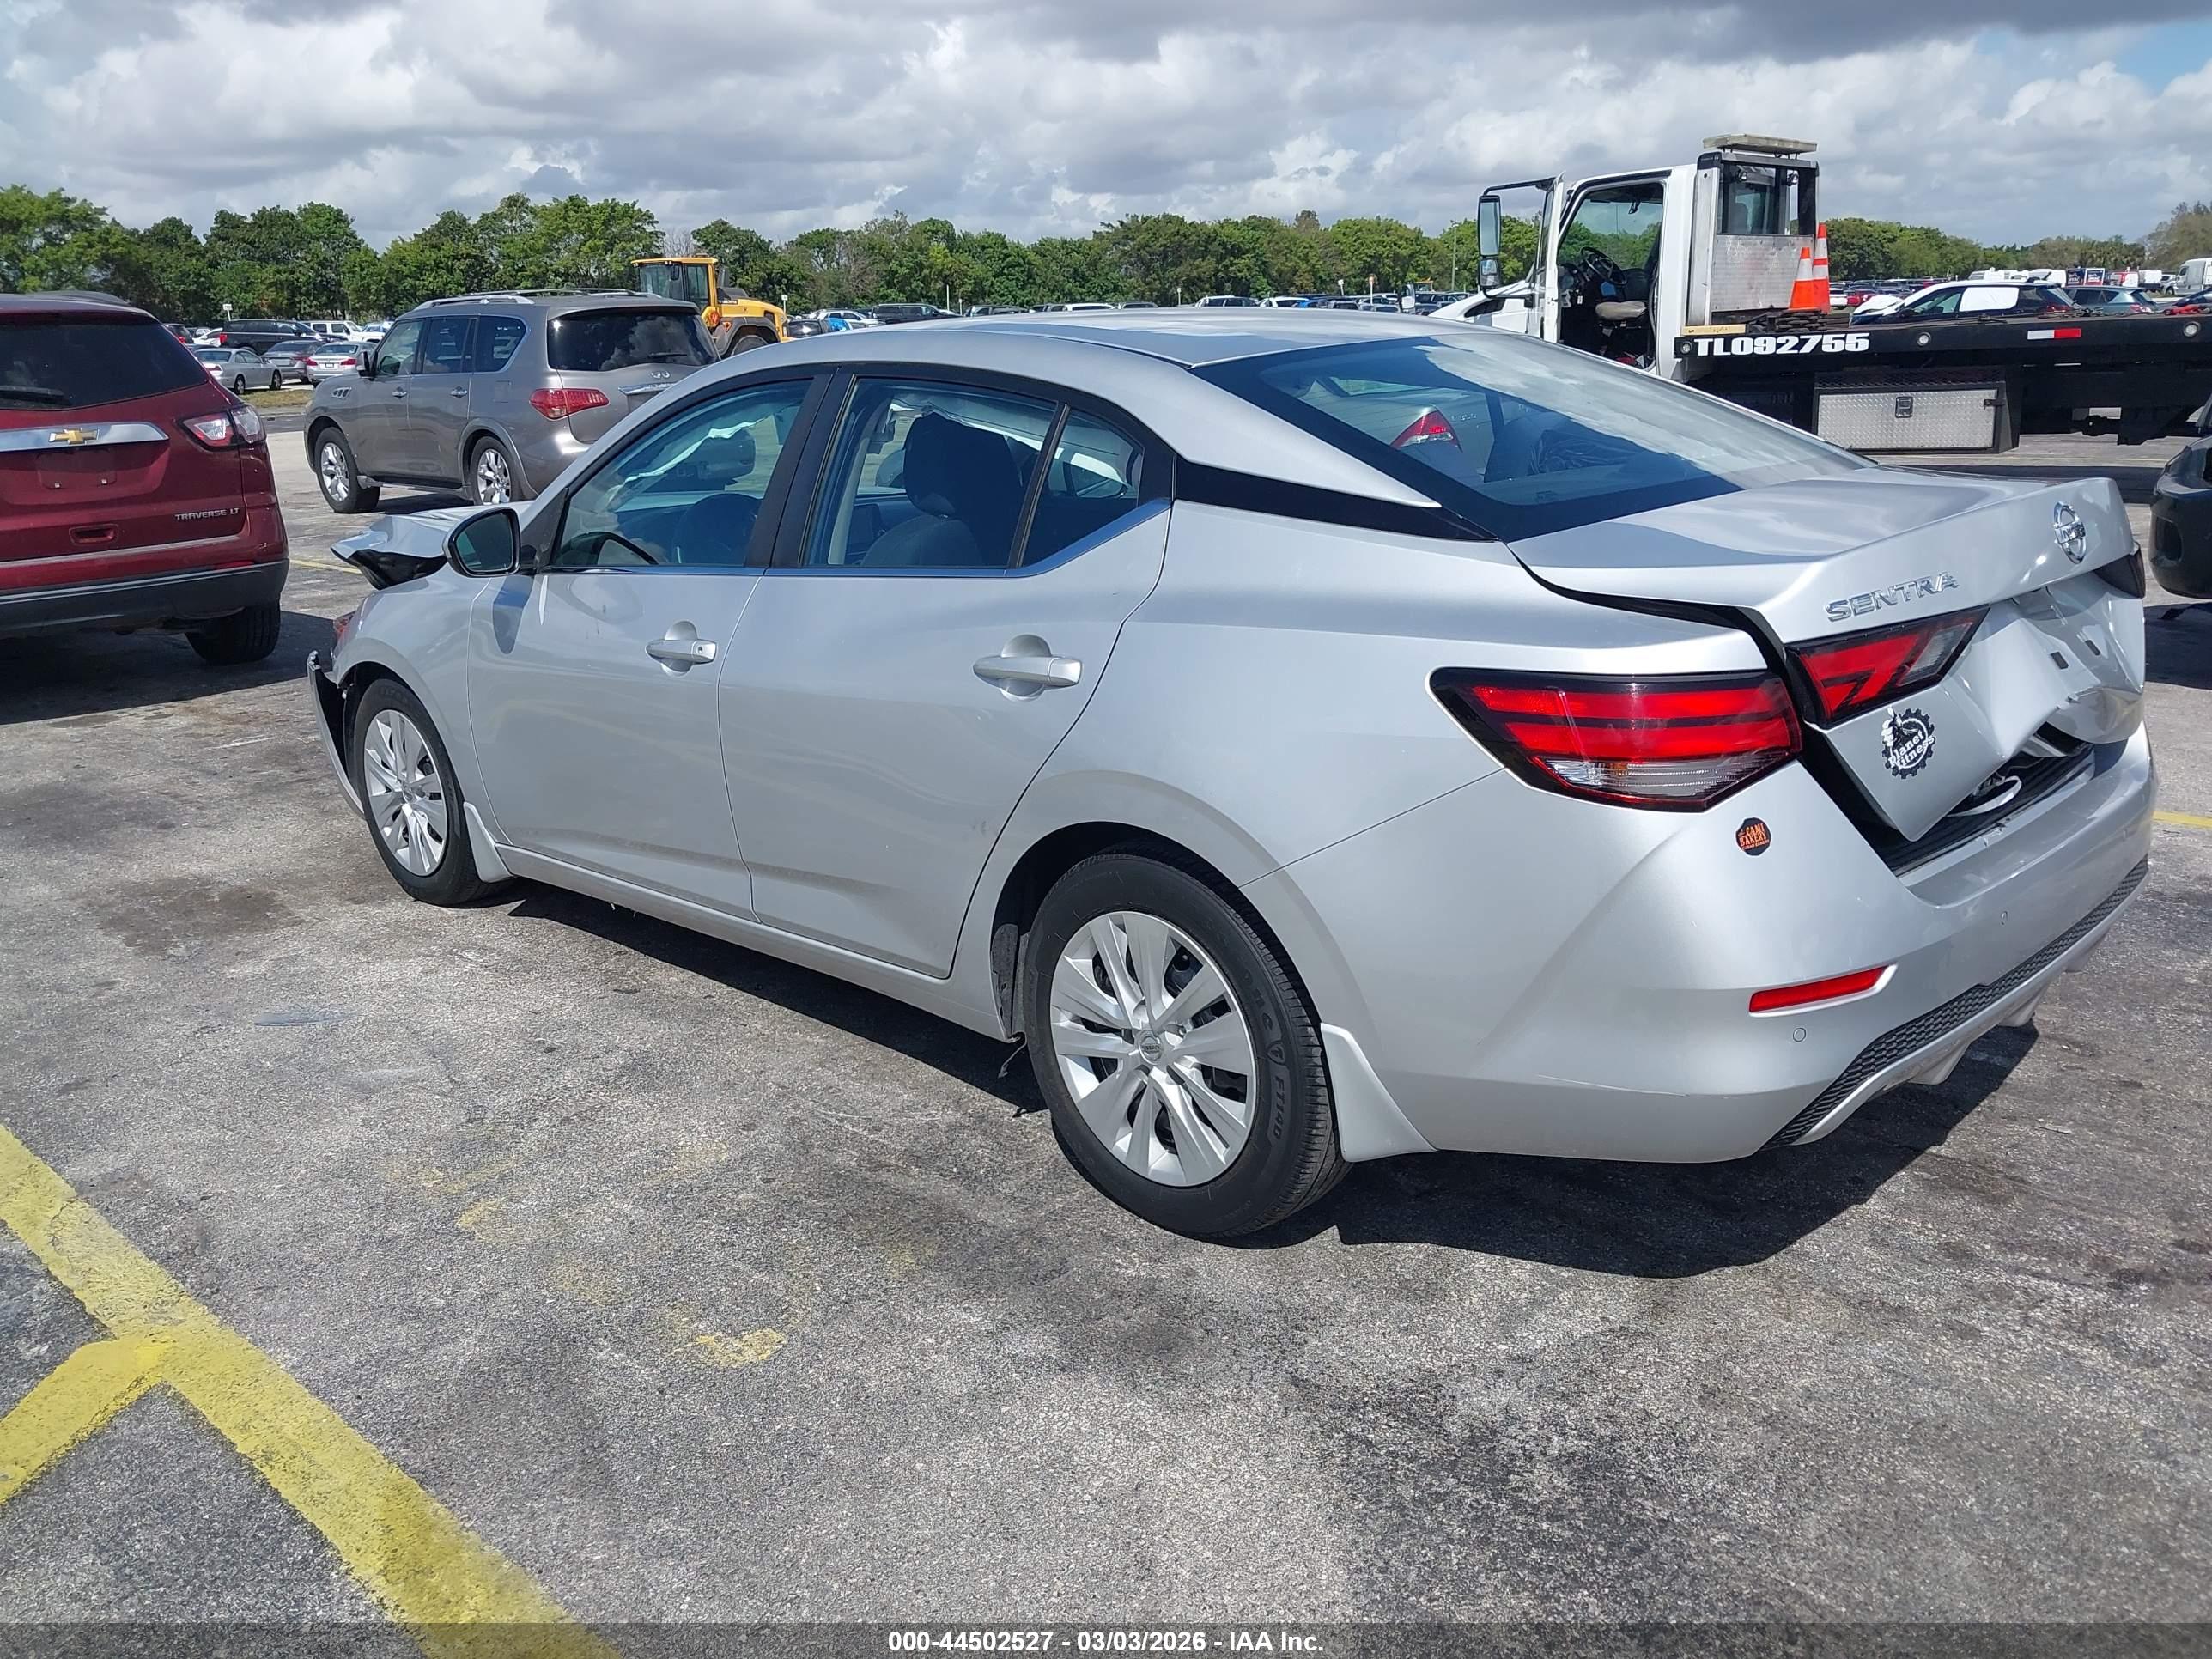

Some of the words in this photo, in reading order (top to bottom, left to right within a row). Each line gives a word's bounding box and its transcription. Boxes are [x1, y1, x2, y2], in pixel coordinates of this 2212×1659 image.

[1693, 332, 1870, 356] TL092755
[174, 509, 228, 520] TRAVERSE
[1825, 571, 1959, 622] SENTRA
[1739, 830, 1767, 847] BAKERY
